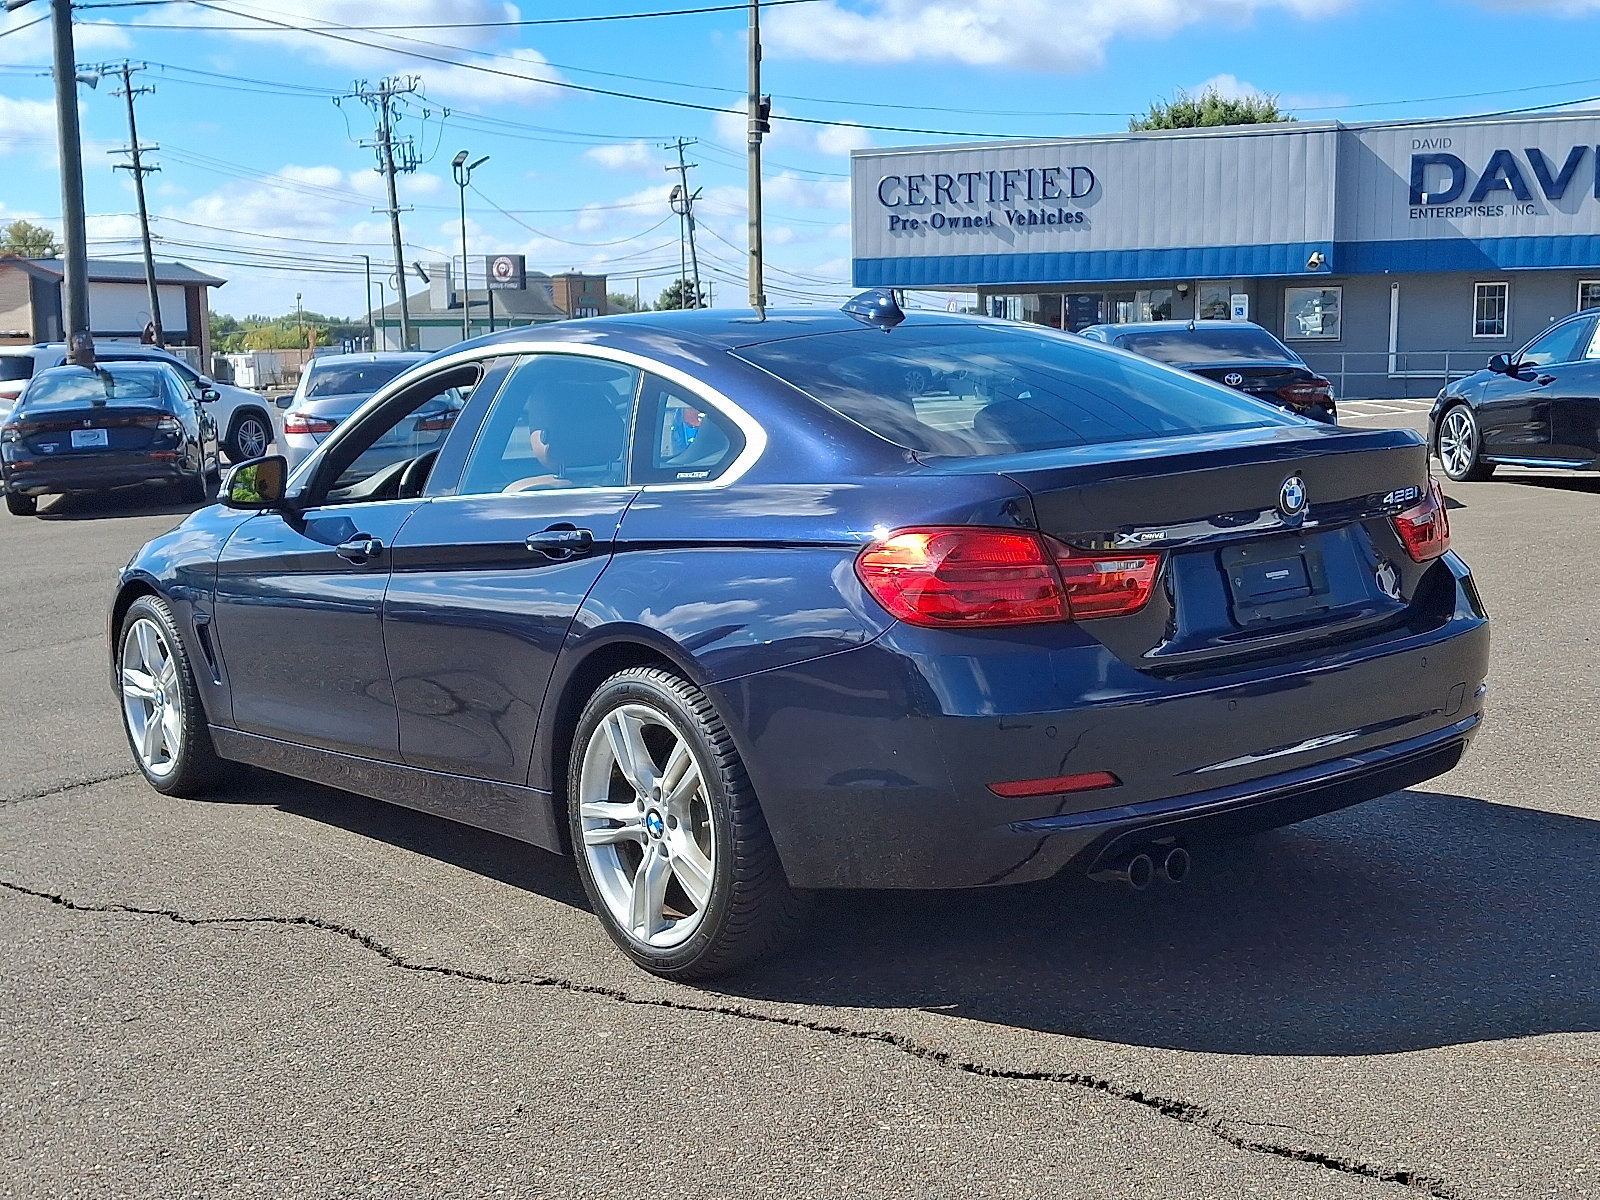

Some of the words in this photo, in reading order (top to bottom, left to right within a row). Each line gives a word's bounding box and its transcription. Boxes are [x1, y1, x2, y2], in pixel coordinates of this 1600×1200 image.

[1411, 137, 1452, 150] DAVID
[877, 165, 1095, 208] CERTIFIED
[888, 210, 993, 232] Pre-Owned
[1004, 207, 1084, 227] Vehicles
[1511, 203, 1538, 217] INC.
